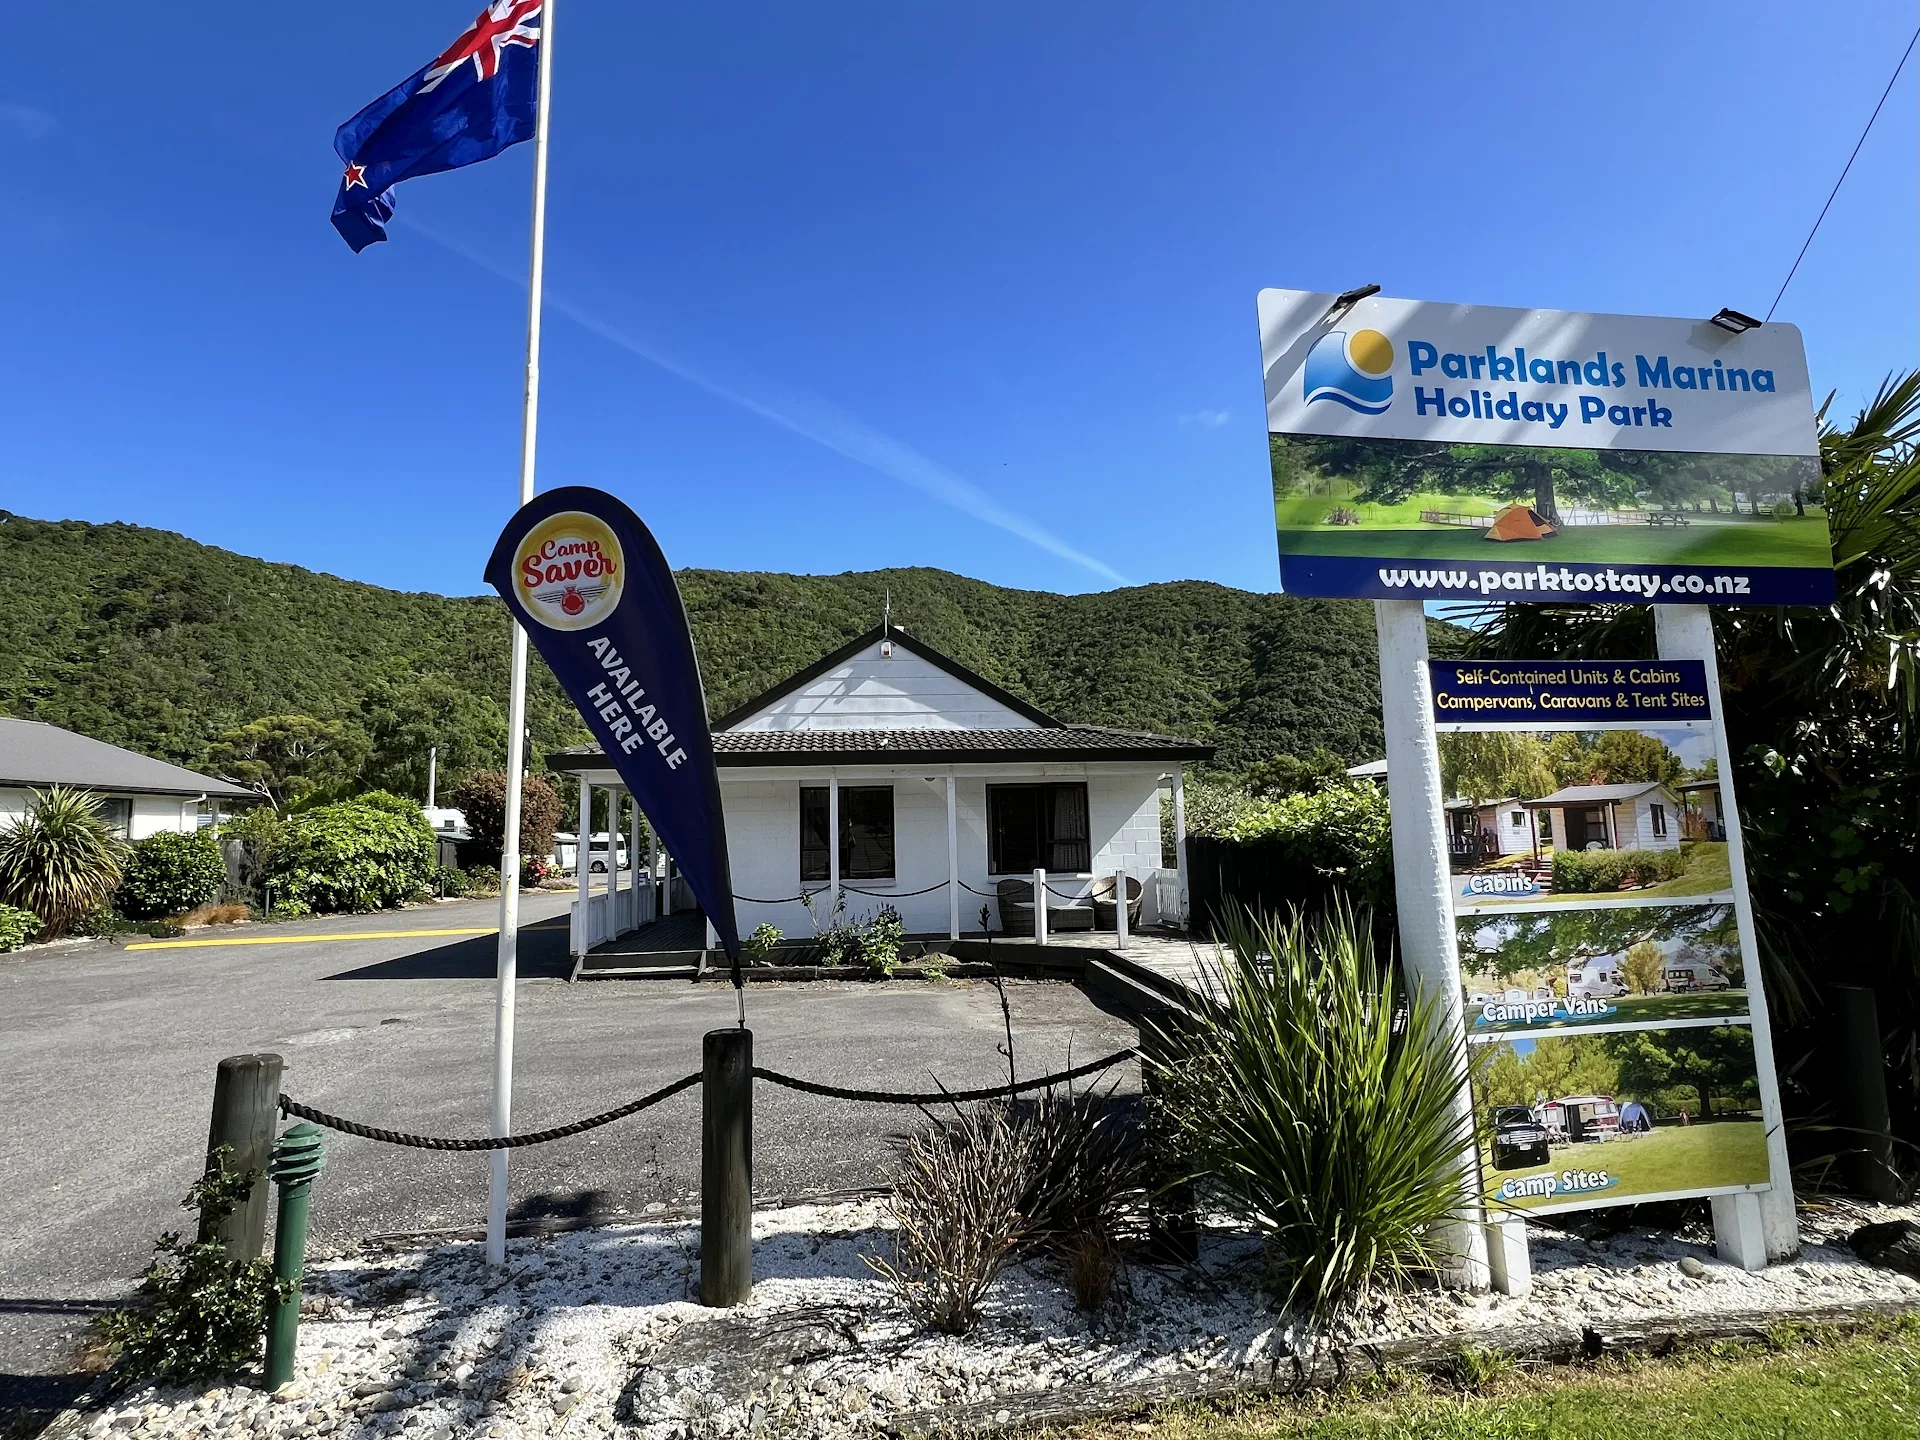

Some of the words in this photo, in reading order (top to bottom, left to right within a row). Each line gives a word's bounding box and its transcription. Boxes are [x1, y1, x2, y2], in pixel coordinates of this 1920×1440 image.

[1407, 341, 1626, 388] Parklands
[1635, 355, 1776, 393] Marina
[1415, 386, 1568, 429] Holiday
[1579, 395, 1673, 428] Park
[541, 540, 600, 560] Camp
[522, 551, 617, 588] Saver
[1379, 565, 1751, 598] www.parktostay.co.nz
[1456, 669, 1567, 685] Self-Contained
[1571, 669, 1608, 684] Units
[1612, 669, 1626, 684] &
[1629, 669, 1680, 684] Cabins
[587, 636, 687, 770] AVAILABLE
[1437, 693, 1537, 712] Campervans,
[1540, 693, 1611, 708] Caravans
[1615, 692, 1629, 707] &
[1632, 692, 1666, 708] Tent
[1671, 692, 1706, 708] Sites
[587, 682, 644, 755] HERE
[1469, 874, 1533, 894] Cabins
[1481, 1000, 1557, 1024] Camper
[1564, 997, 1608, 1016] Vans
[1501, 1174, 1556, 1198] Camp
[1562, 1168, 1609, 1191] Sites
